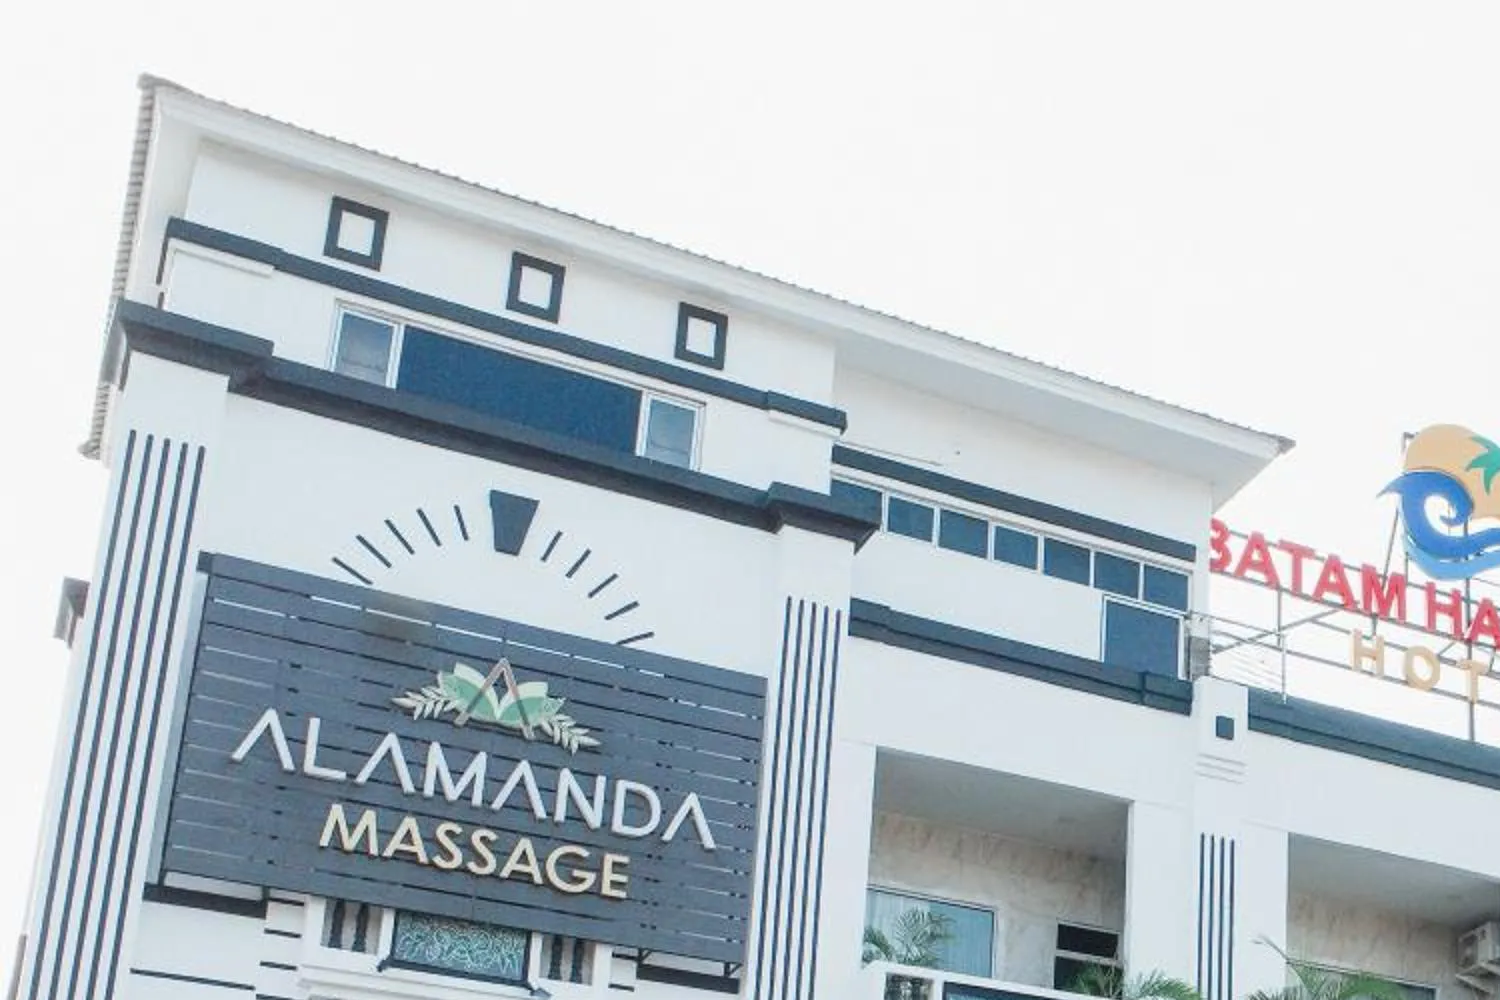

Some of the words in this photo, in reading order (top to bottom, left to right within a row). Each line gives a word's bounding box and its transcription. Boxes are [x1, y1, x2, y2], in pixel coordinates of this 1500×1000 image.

[1209, 518, 1406, 622] BATAM
[231, 707, 717, 850] ALAMANDA
[318, 803, 630, 899] MASSAGE
